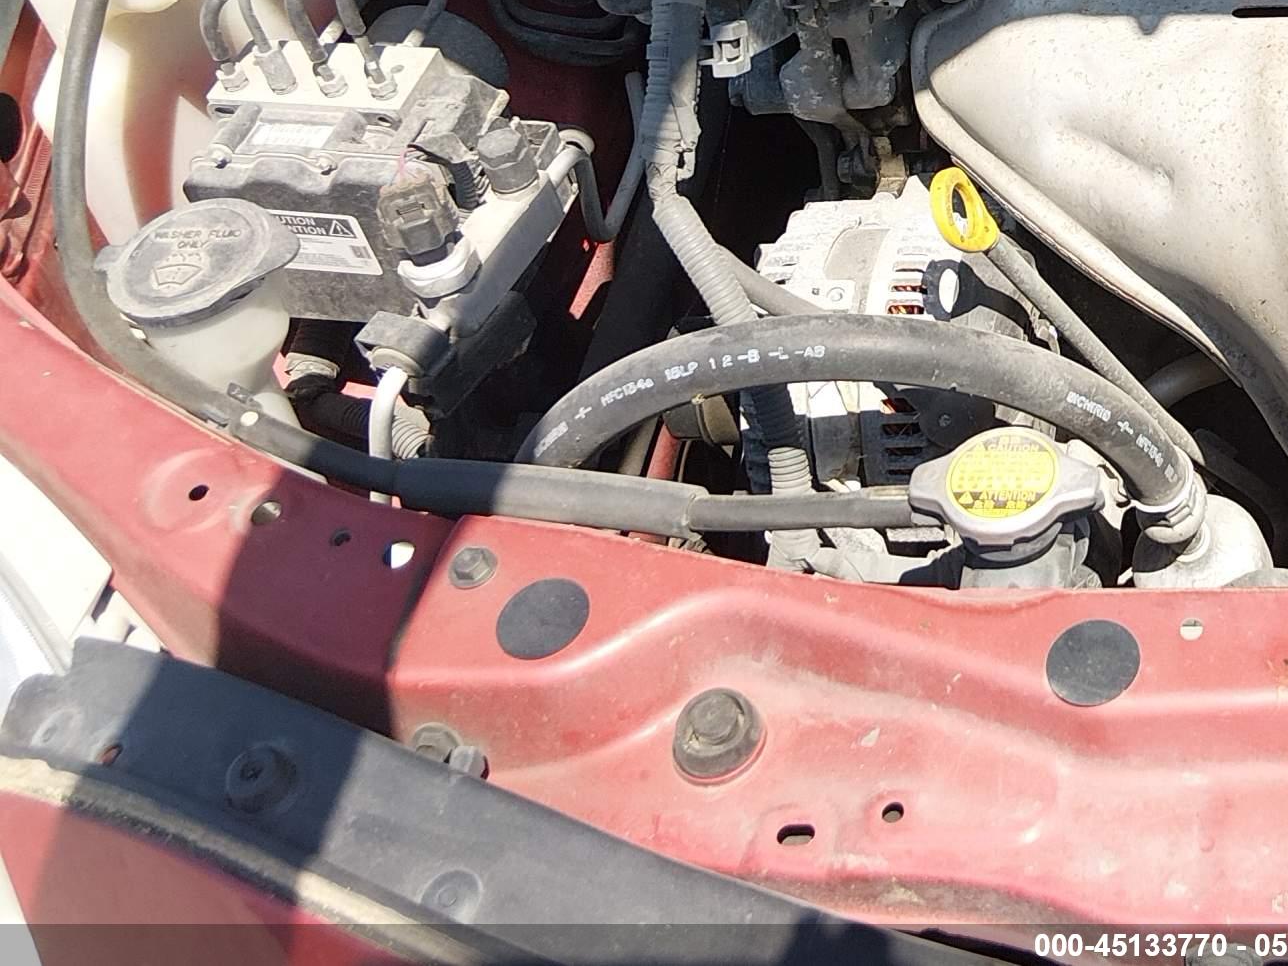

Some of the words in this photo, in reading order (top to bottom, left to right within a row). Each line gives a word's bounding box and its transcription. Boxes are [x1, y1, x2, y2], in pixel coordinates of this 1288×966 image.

[177, 240, 210, 249] ONLY
[988, 444, 1039, 452] CAUTION
[979, 490, 1035, 501] ATTENTION
